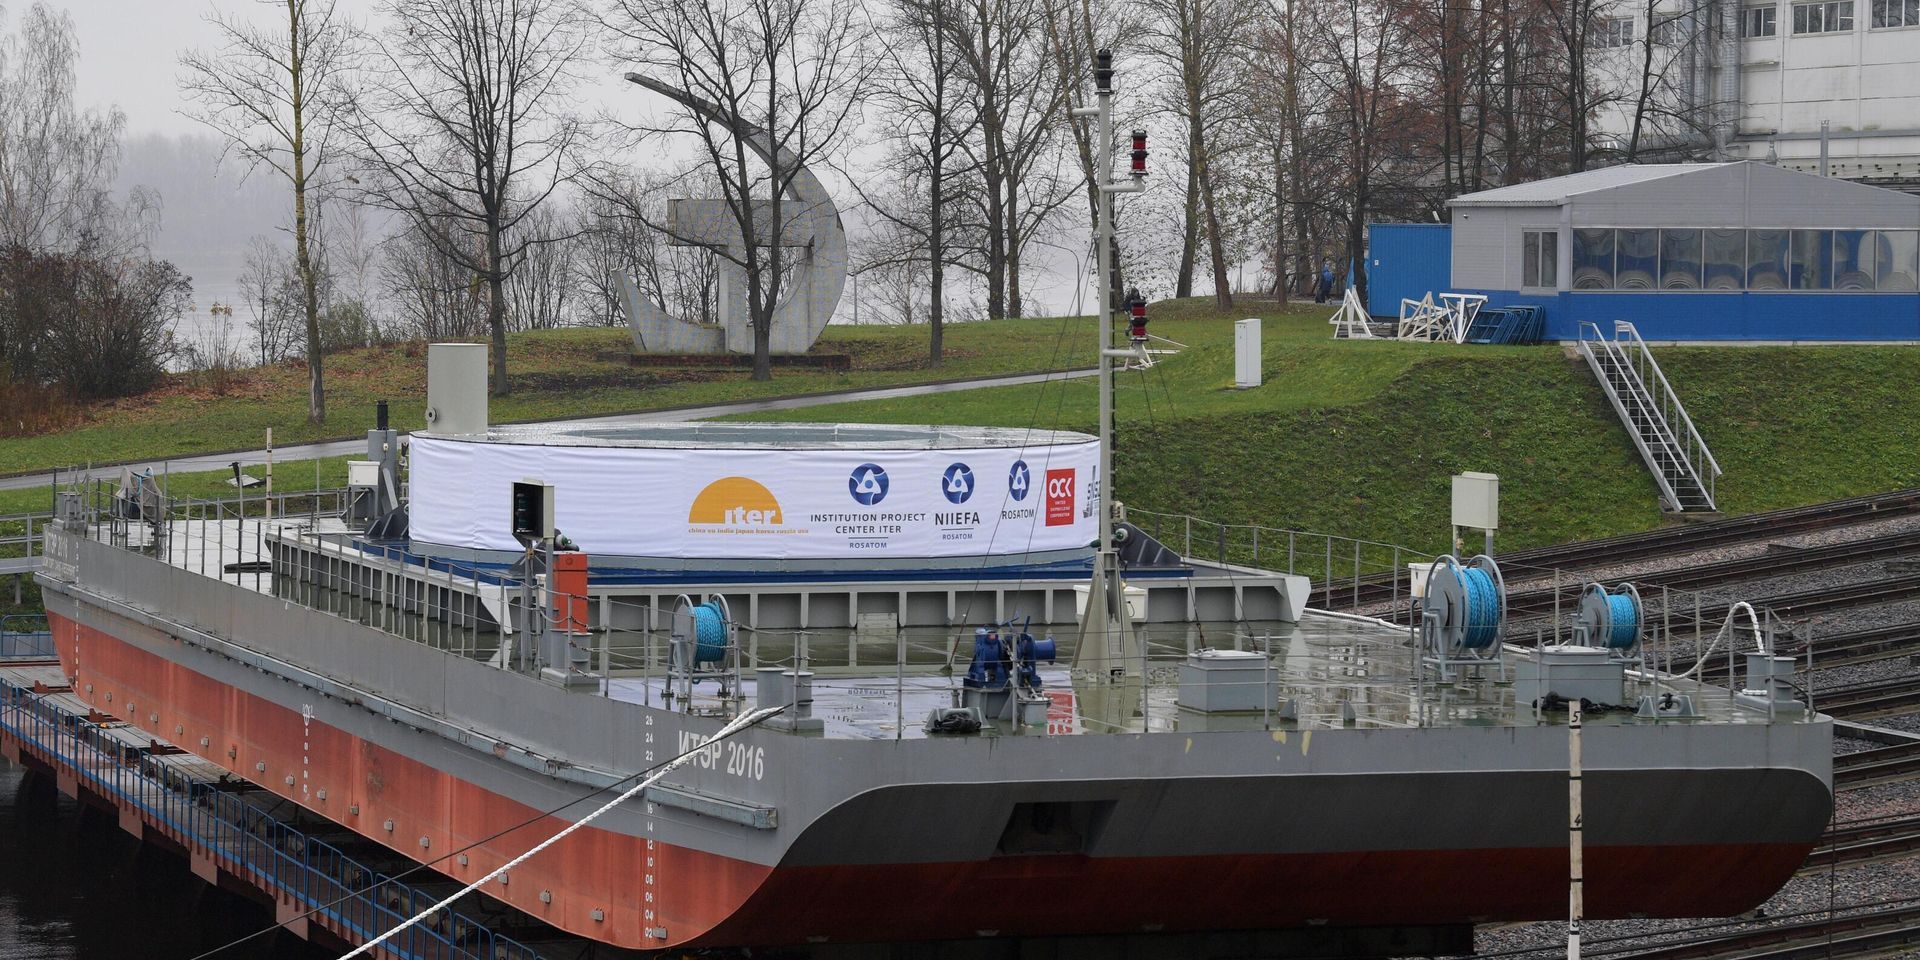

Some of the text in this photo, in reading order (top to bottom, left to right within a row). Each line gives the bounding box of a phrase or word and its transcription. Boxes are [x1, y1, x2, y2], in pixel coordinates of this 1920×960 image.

[724, 506, 776, 526] iter
[810, 513, 926, 522] INSTITUTION PROJECT
[935, 512, 980, 526] NIIEFA
[1002, 509, 1034, 520] ROSATOM
[835, 525, 902, 534] CENTER ITER
[1571, 710, 1580, 723] 5
[645, 732, 653, 743] 24
[645, 750, 653, 762] 22
[727, 741, 764, 781] 2016
[1574, 814, 1582, 827] 4
[647, 839, 653, 850] 12
[647, 856, 653, 867] 10
